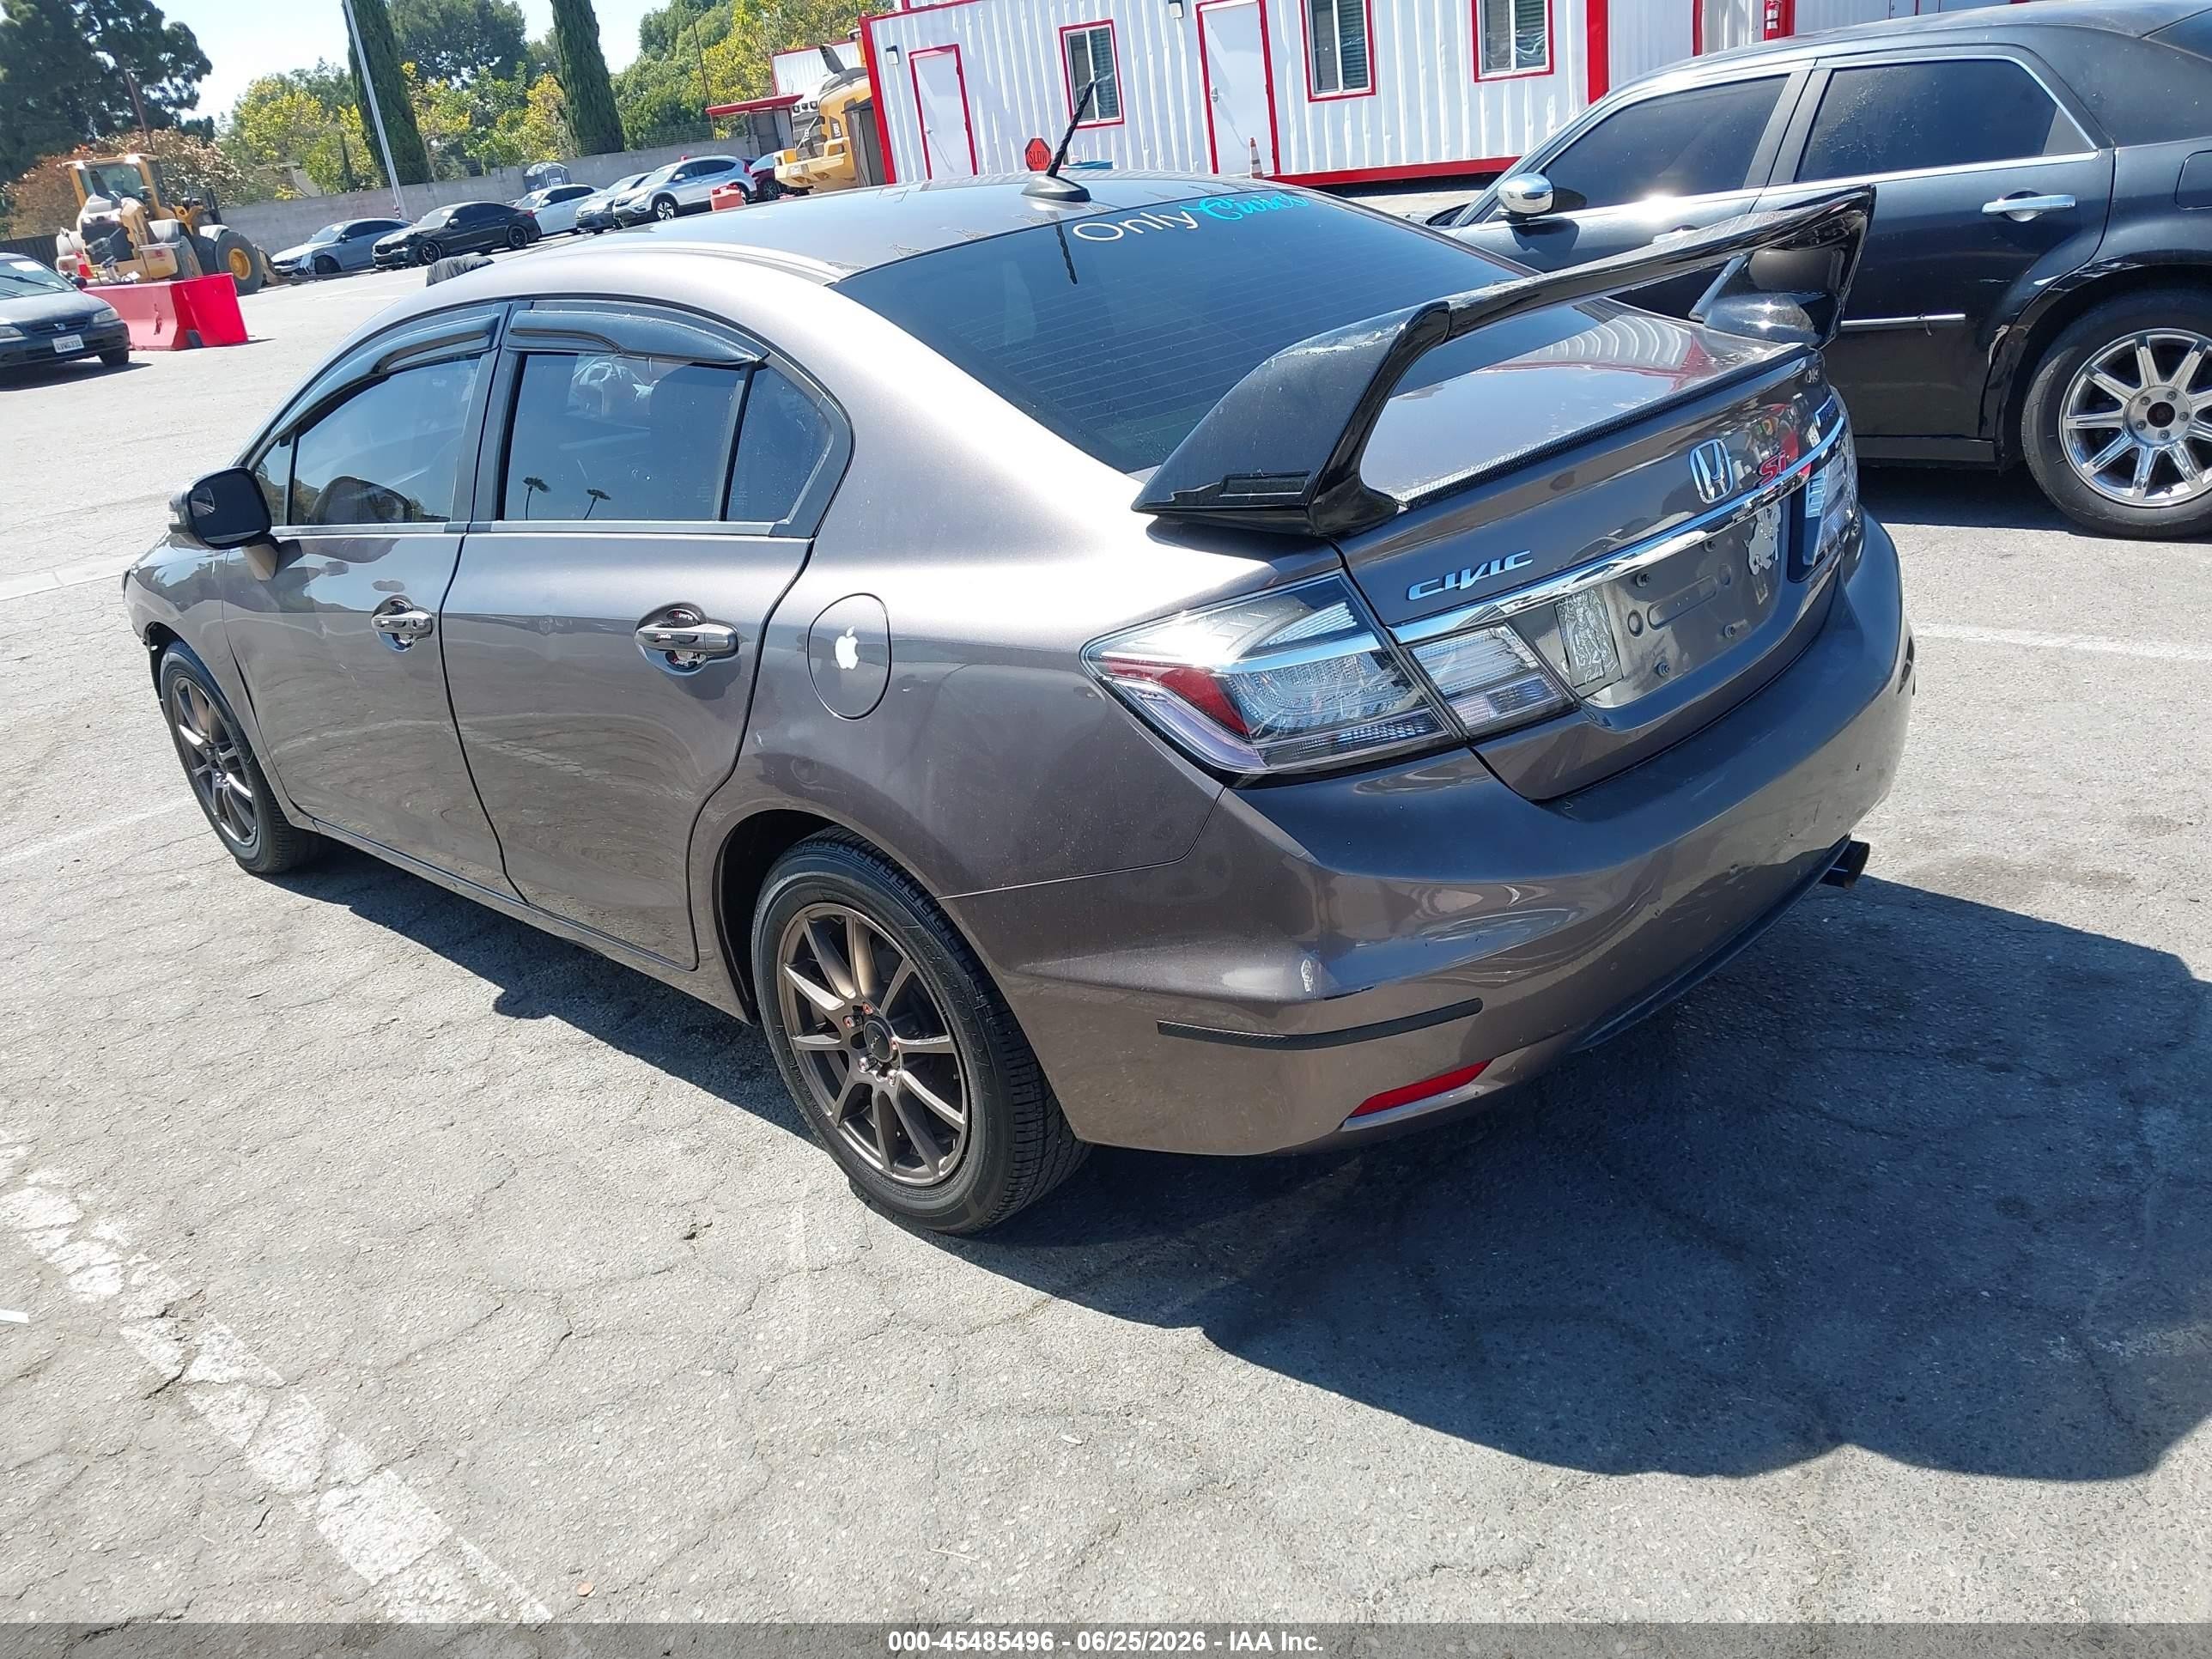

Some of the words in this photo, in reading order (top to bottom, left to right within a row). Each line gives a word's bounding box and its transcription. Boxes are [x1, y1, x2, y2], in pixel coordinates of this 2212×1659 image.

[1028, 149, 1048, 166] SLOW
[1758, 450, 1787, 487] Si
[1408, 550, 1534, 600] CIVIC
